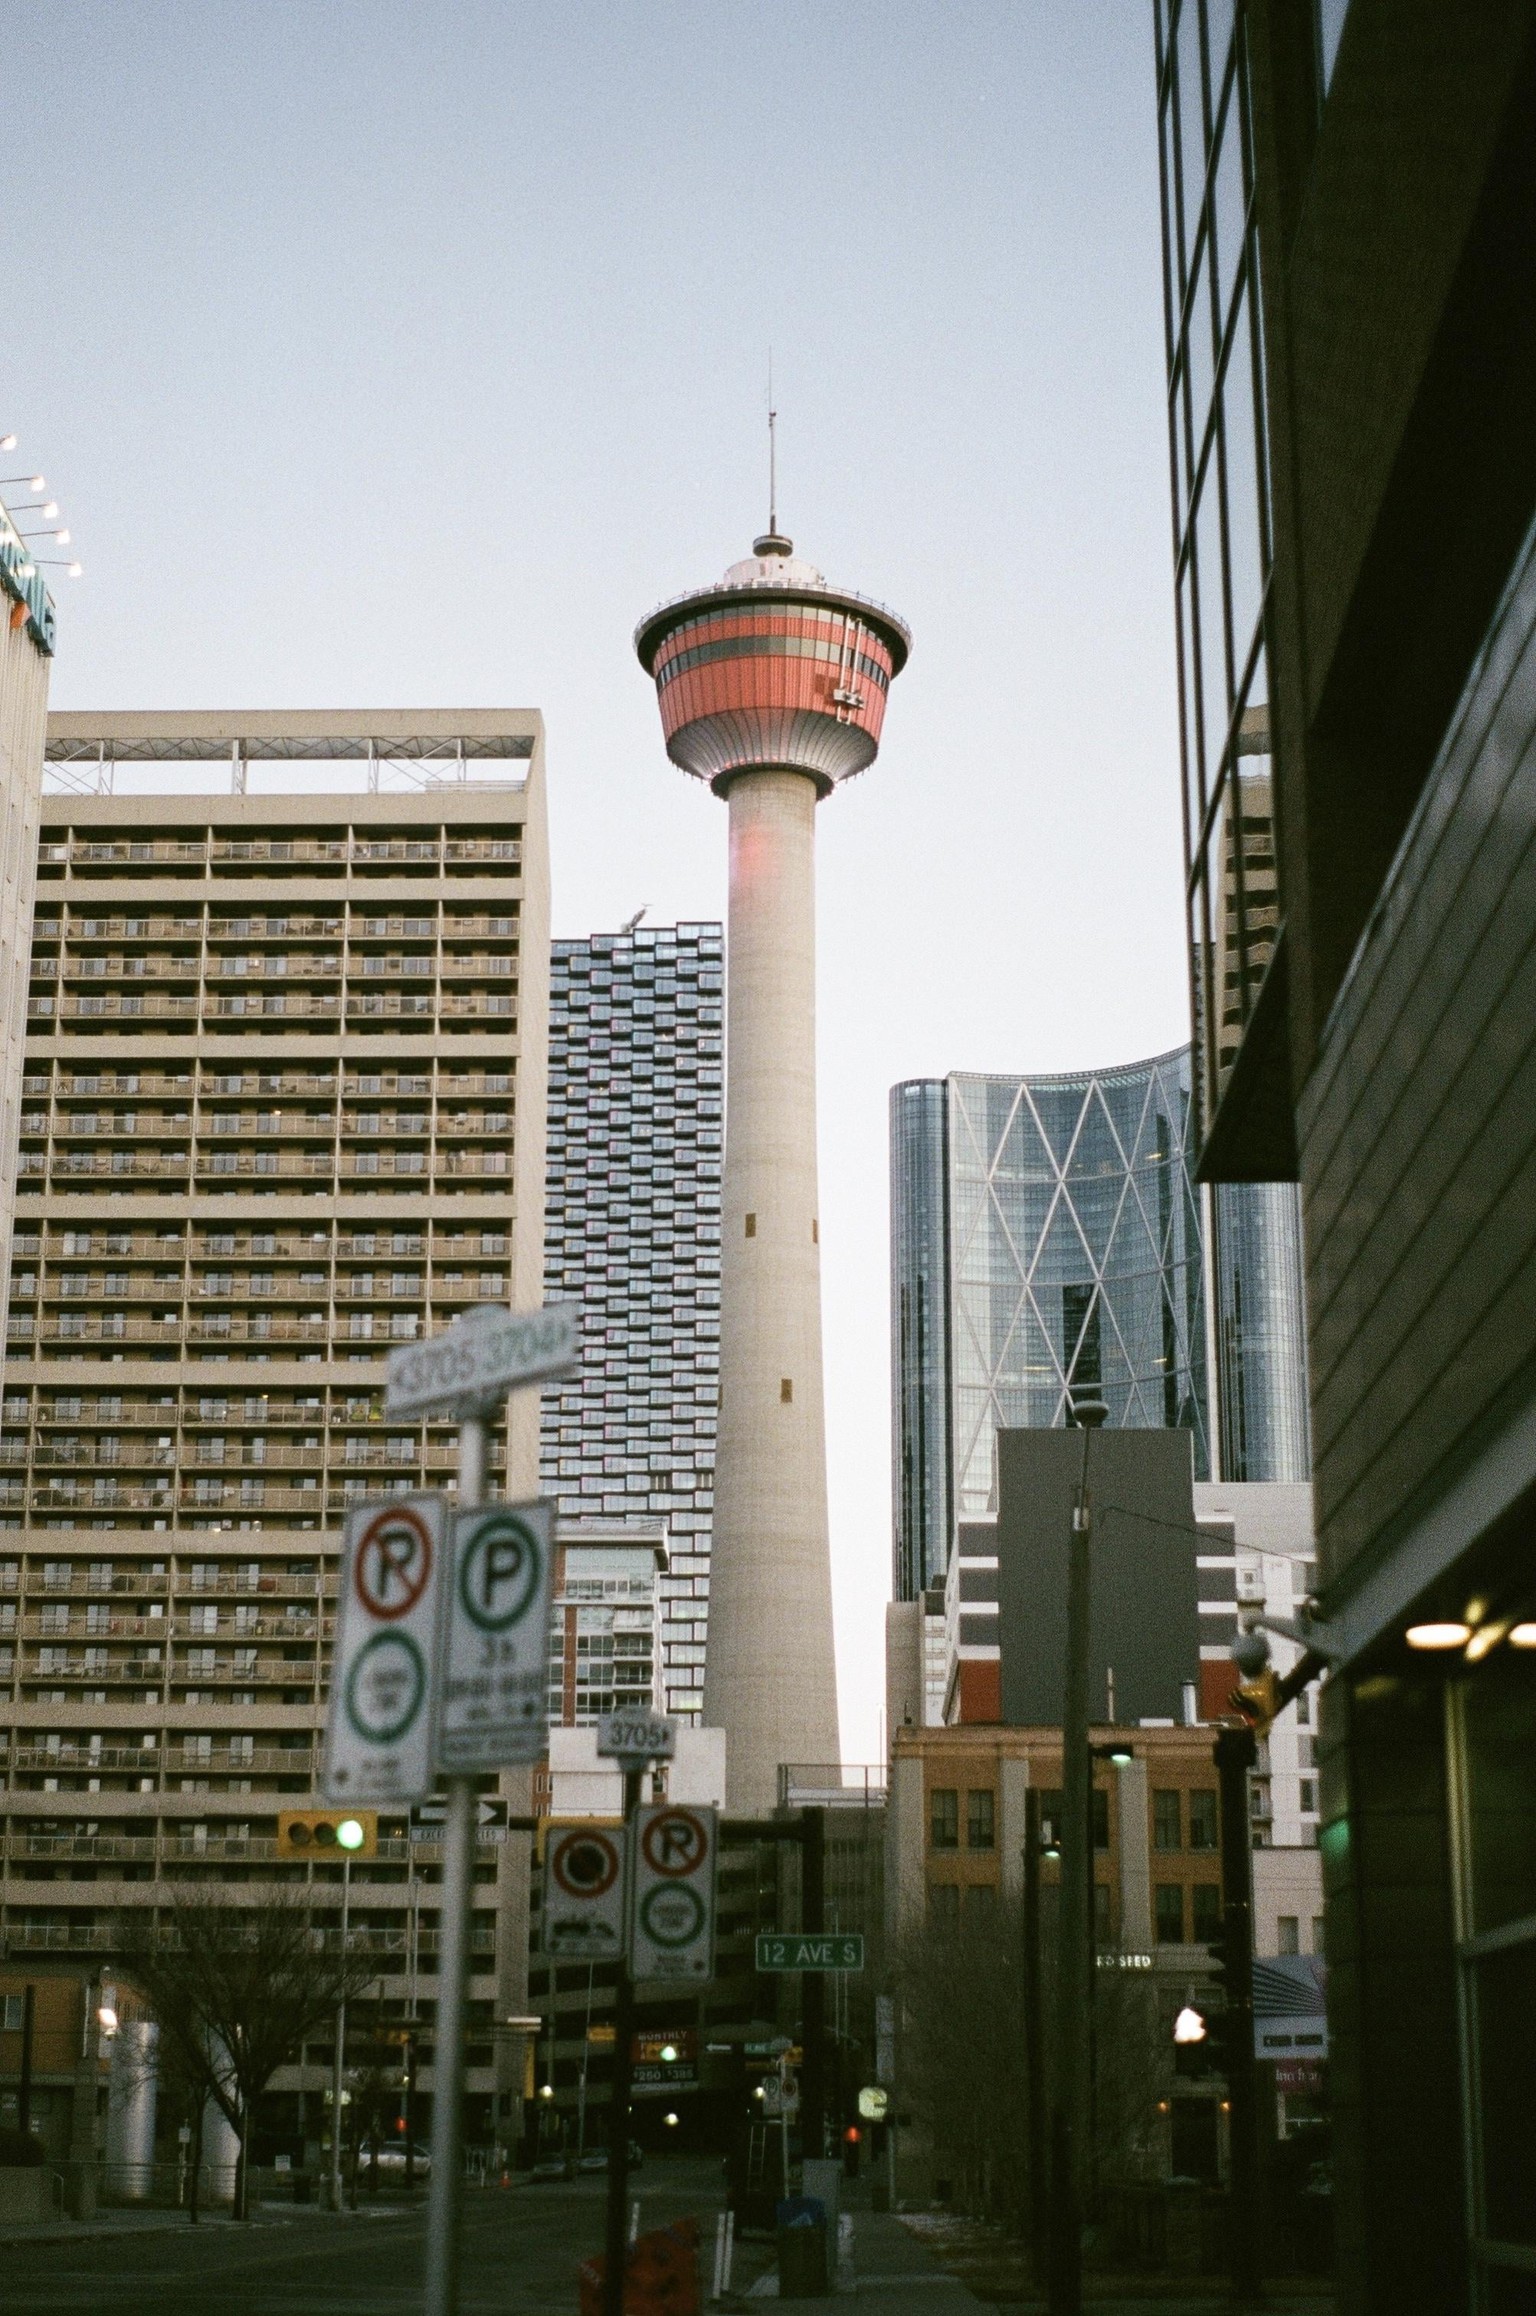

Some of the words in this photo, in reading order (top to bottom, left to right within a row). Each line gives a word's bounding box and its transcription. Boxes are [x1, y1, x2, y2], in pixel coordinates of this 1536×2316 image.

[409, 1339, 475, 1391] 3705
[610, 1721, 661, 1747] 3705
[763, 1943, 785, 1963] 12
[795, 1942, 834, 1963] AVE
[843, 1942, 856, 1963] S
[638, 2030, 688, 2041] MONTHLY
